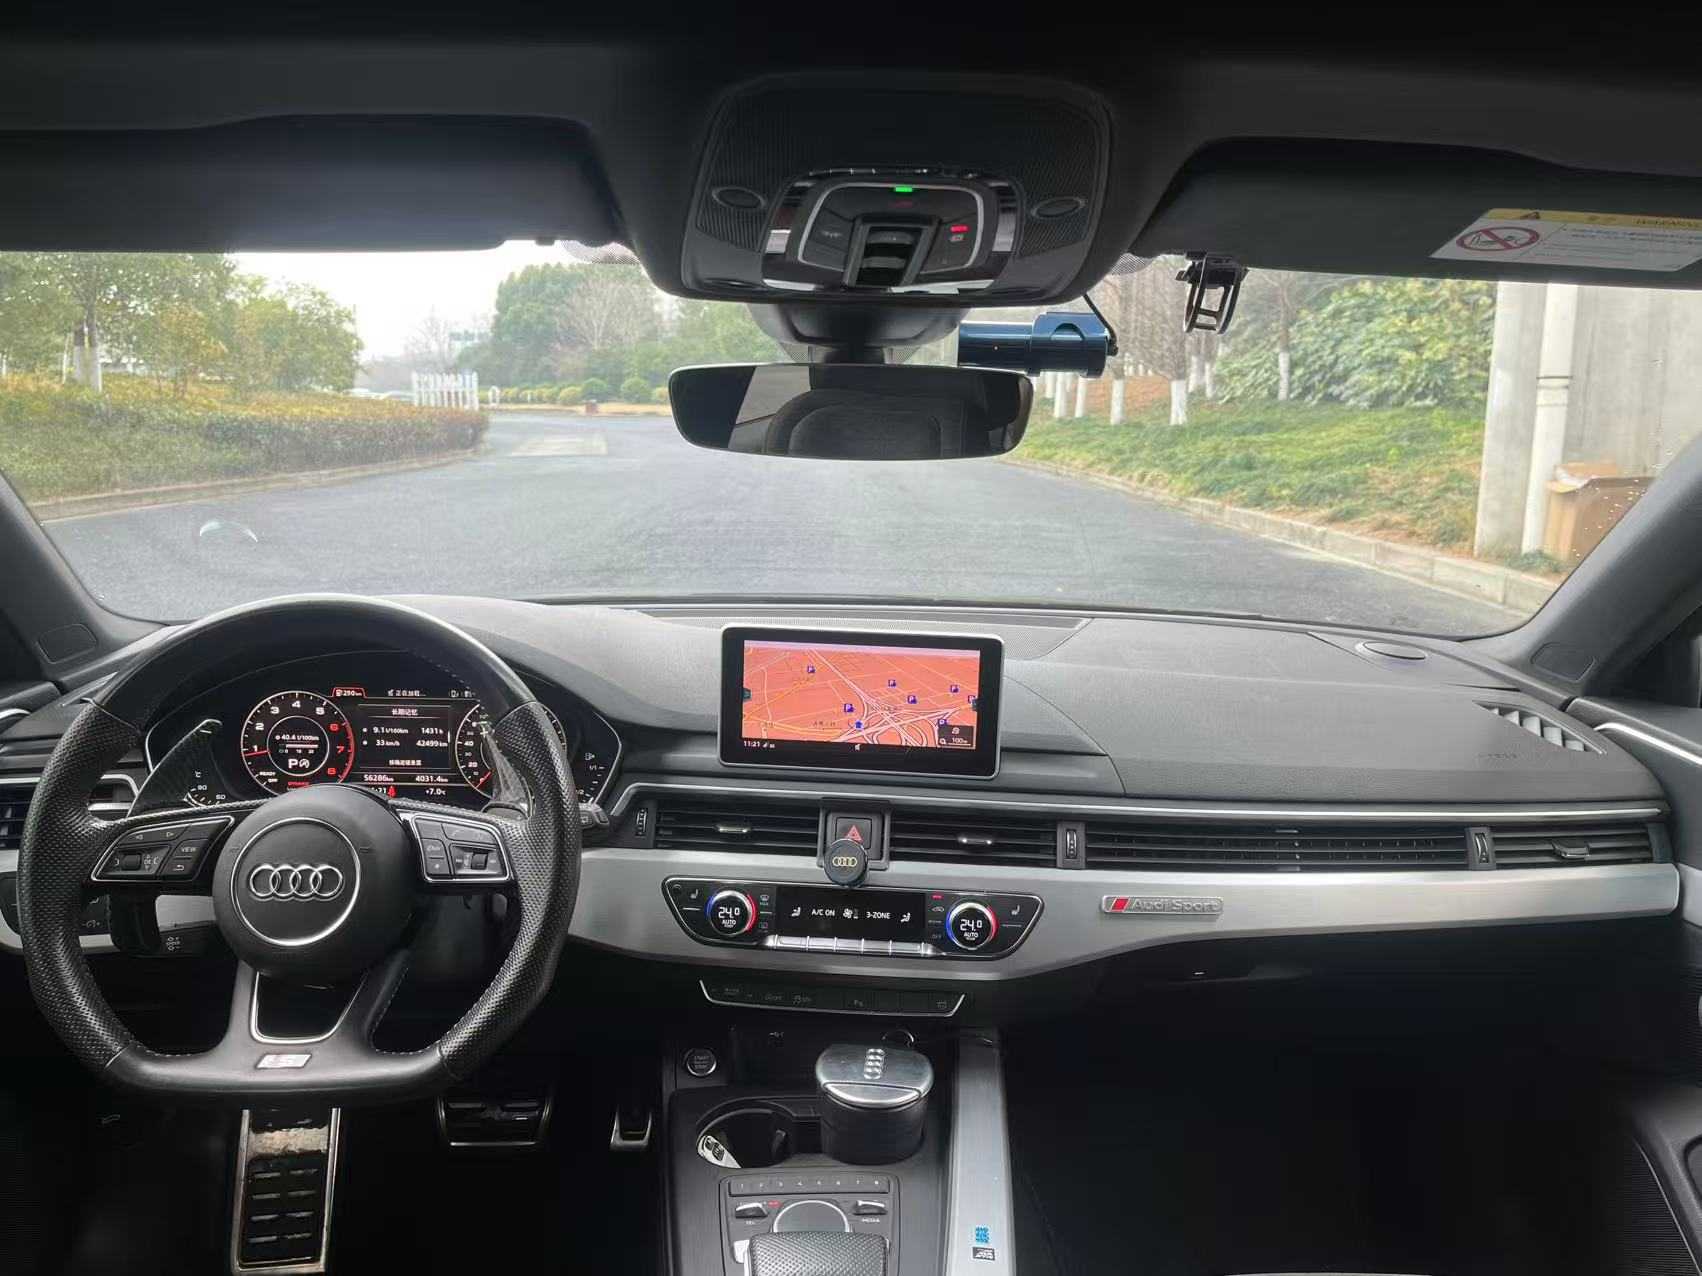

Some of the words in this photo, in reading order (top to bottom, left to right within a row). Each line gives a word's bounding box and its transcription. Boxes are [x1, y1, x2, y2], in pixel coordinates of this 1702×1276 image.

[270, 706, 280, 714] 3
[315, 707, 325, 715] 5
[255, 723, 264, 731] 2
[743, 740, 761, 748] 11:21
[336, 745, 345, 754] 7
[287, 758, 299, 769] P
[1134, 898, 1169, 911] Audi
[1172, 899, 1220, 913] Sport
[811, 908, 824, 916] A/C
[866, 911, 892, 919] 3-ZONE
